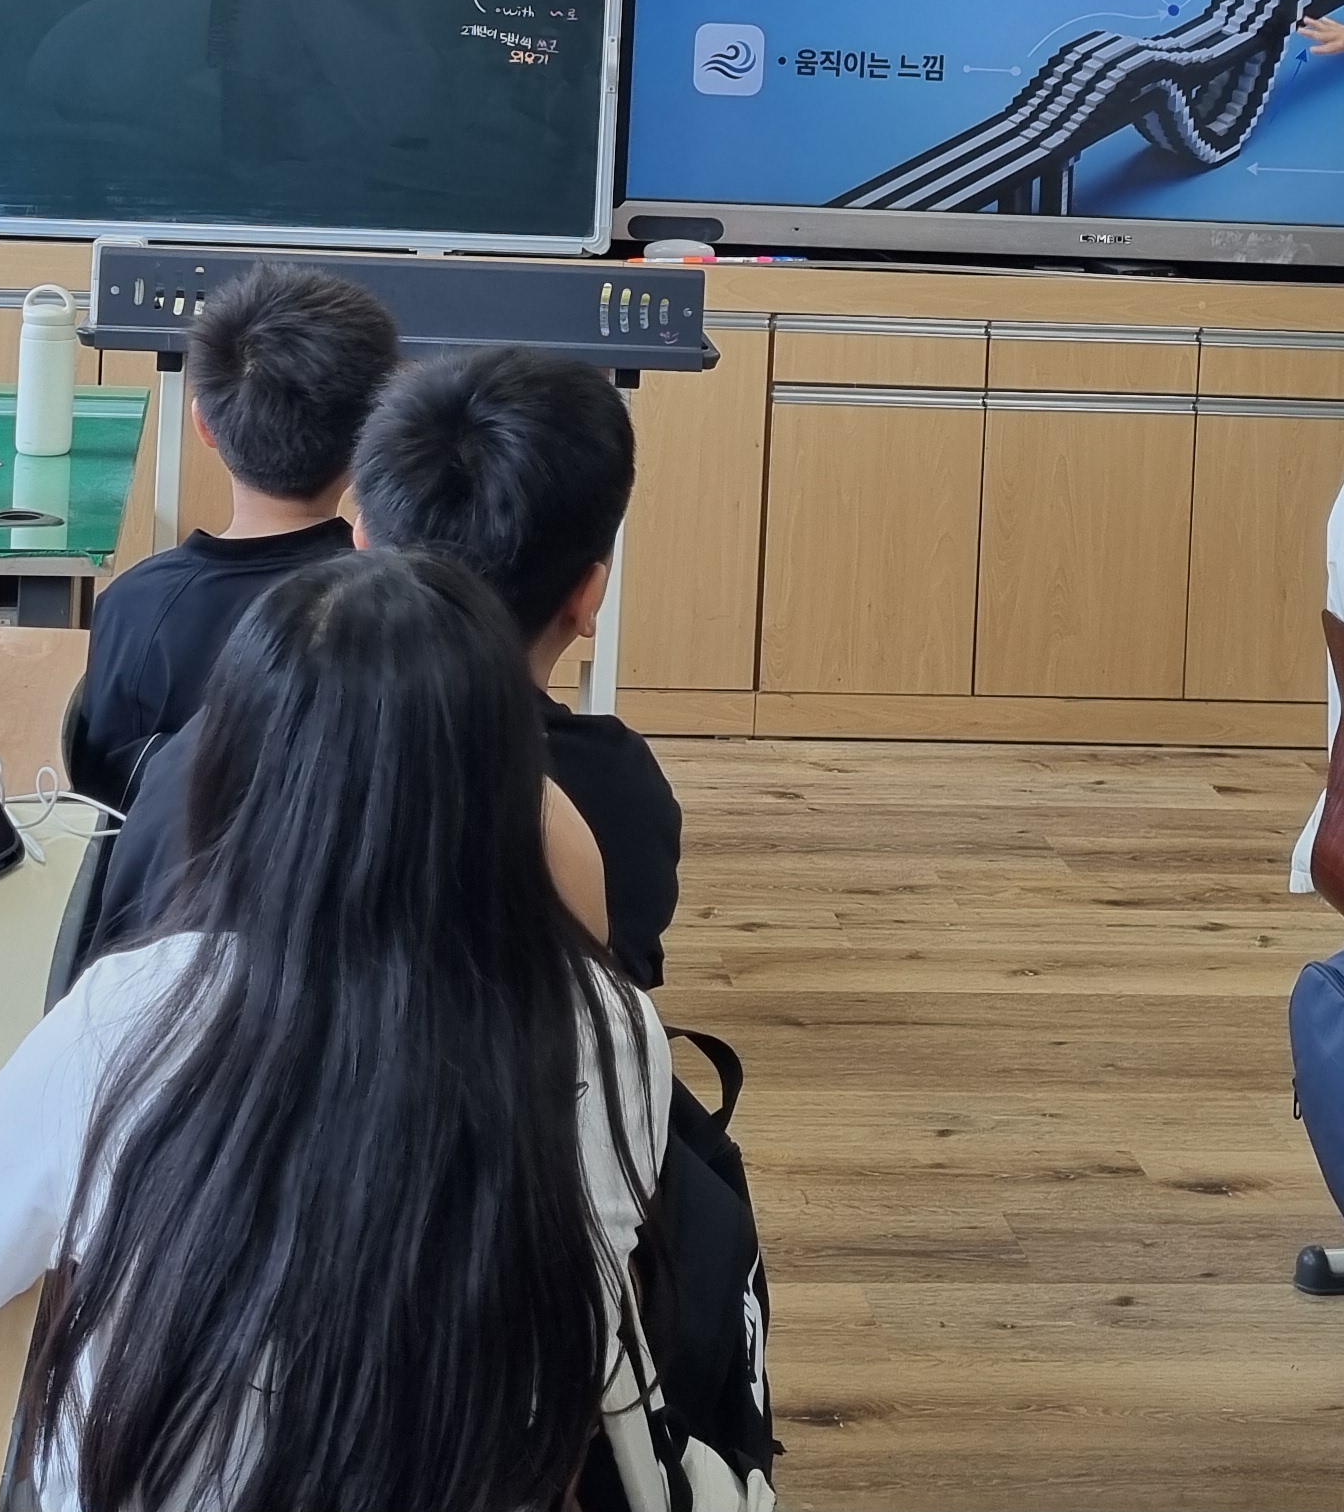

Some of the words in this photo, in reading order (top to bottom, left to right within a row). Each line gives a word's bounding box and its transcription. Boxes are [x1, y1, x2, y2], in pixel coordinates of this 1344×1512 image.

[503, 5, 535, 18] with
[794, 49, 891, 79] 움직이는
[897, 54, 945, 81] 느낌
